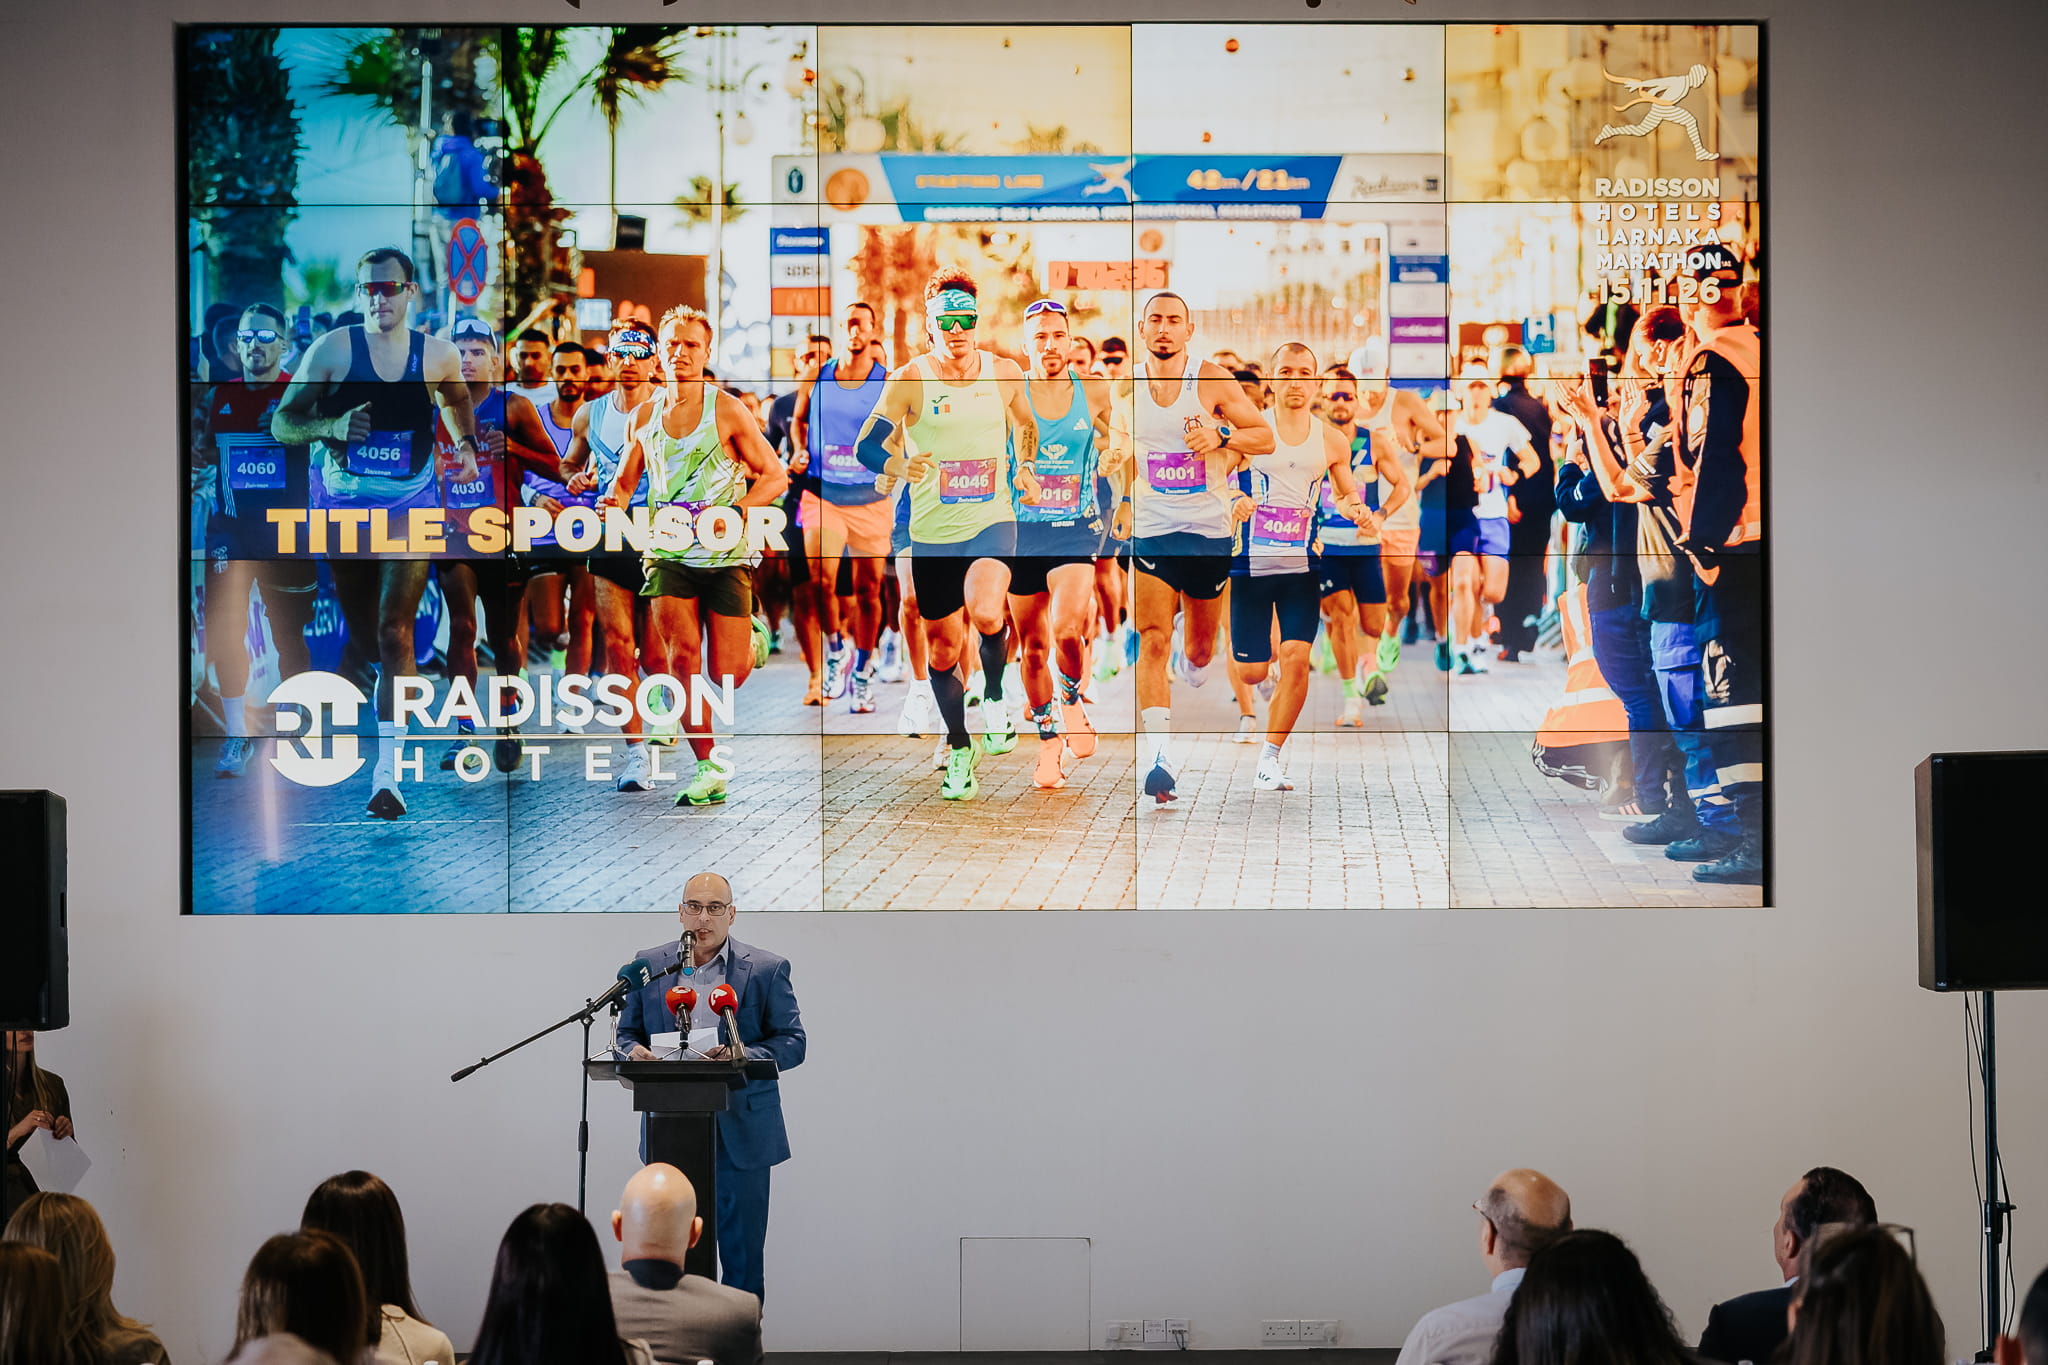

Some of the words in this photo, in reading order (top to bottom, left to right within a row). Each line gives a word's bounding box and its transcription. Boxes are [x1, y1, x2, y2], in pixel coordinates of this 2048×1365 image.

[1595, 177, 1720, 198] RADISSON
[1596, 203, 1721, 221] HOTELS
[1597, 228, 1721, 246] LARNAKA
[1597, 252, 1722, 270] MARATHON
[1598, 277, 1721, 305] 15.11.26
[357, 445, 401, 461] 4056
[237, 462, 276, 475] 4060
[1156, 466, 1195, 480] 4001
[451, 481, 485, 495] 4030
[948, 474, 989, 489] 4046
[1040, 488, 1072, 502] 016
[266, 508, 446, 553] TITLE
[467, 506, 790, 553] SPONSOR
[1263, 519, 1301, 534] 4044
[393, 673, 735, 727] RADISSON
[394, 744, 736, 783] HOTELS
